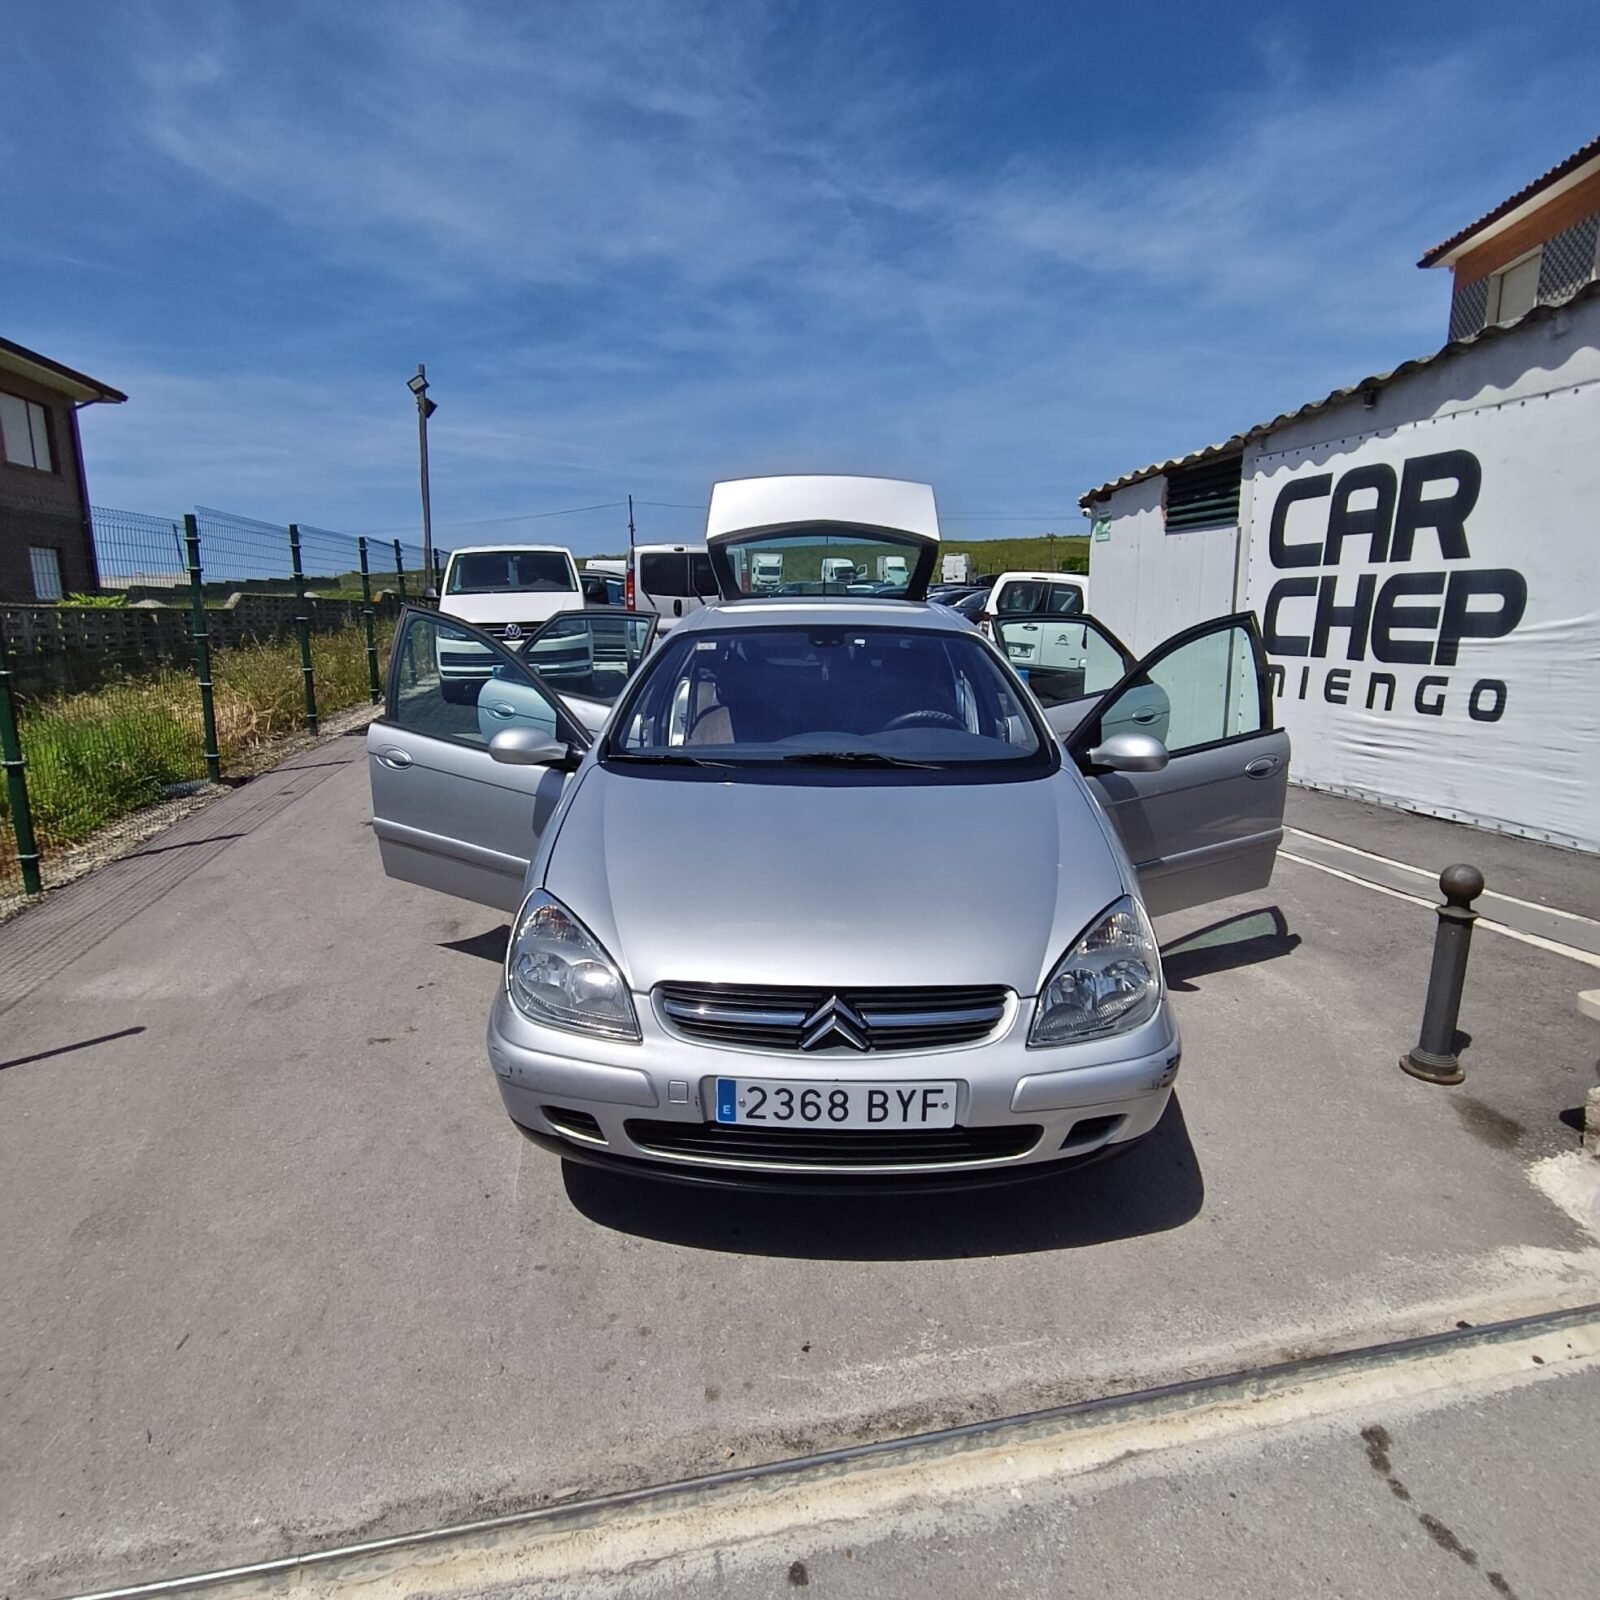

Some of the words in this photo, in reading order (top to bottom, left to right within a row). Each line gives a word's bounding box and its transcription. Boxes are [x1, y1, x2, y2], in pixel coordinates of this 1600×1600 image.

[1269, 449, 1482, 569] CAR
[1264, 568, 1528, 666] CHEP
[723, 1104, 731, 1115] E
[746, 1086, 849, 1122] 2368
[867, 1089, 944, 1123] BYF
